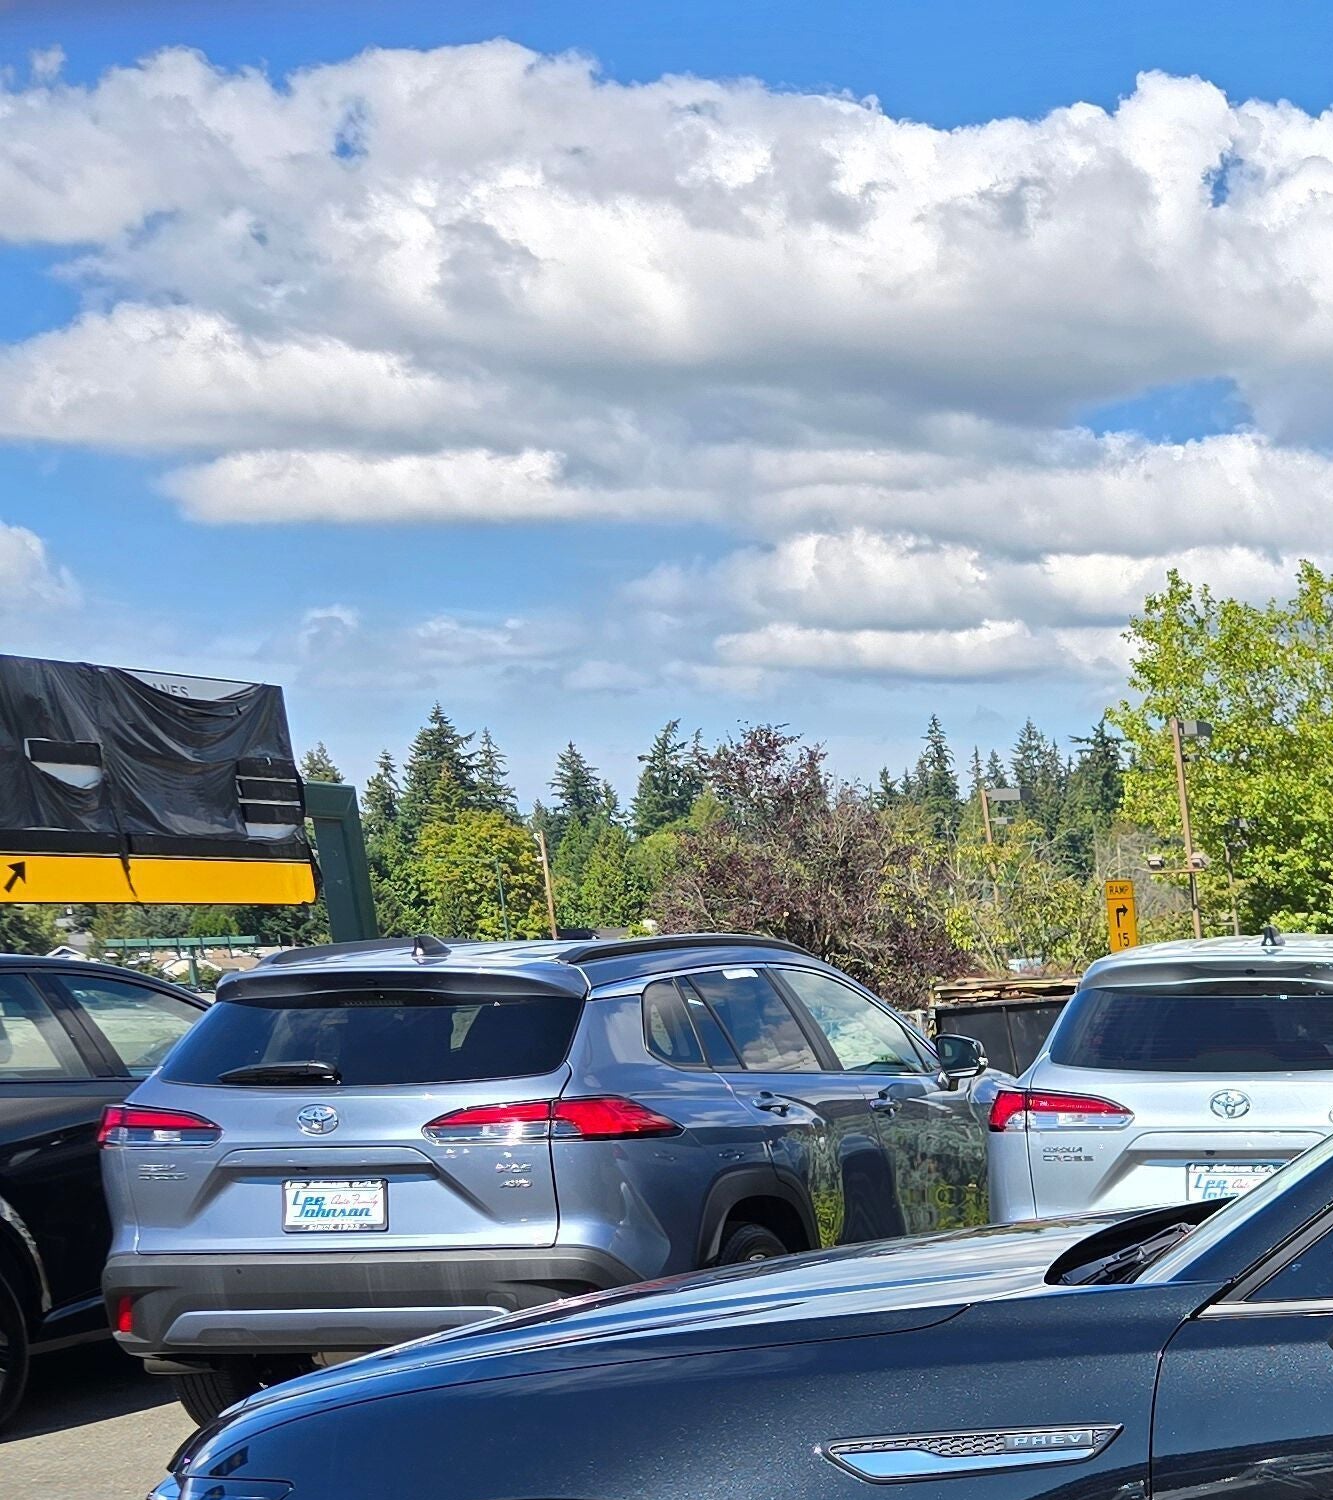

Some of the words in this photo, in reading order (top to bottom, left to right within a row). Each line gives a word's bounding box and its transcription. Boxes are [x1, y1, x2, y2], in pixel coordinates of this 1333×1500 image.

[1109, 886, 1129, 895] RAMP
[1117, 933, 1130, 947] 15
[1194, 1173, 1227, 1188] Lee
[293, 1191, 325, 1206] Lee
[294, 1201, 373, 1218] Johnson
[1015, 1433, 1083, 1446] PHEV
